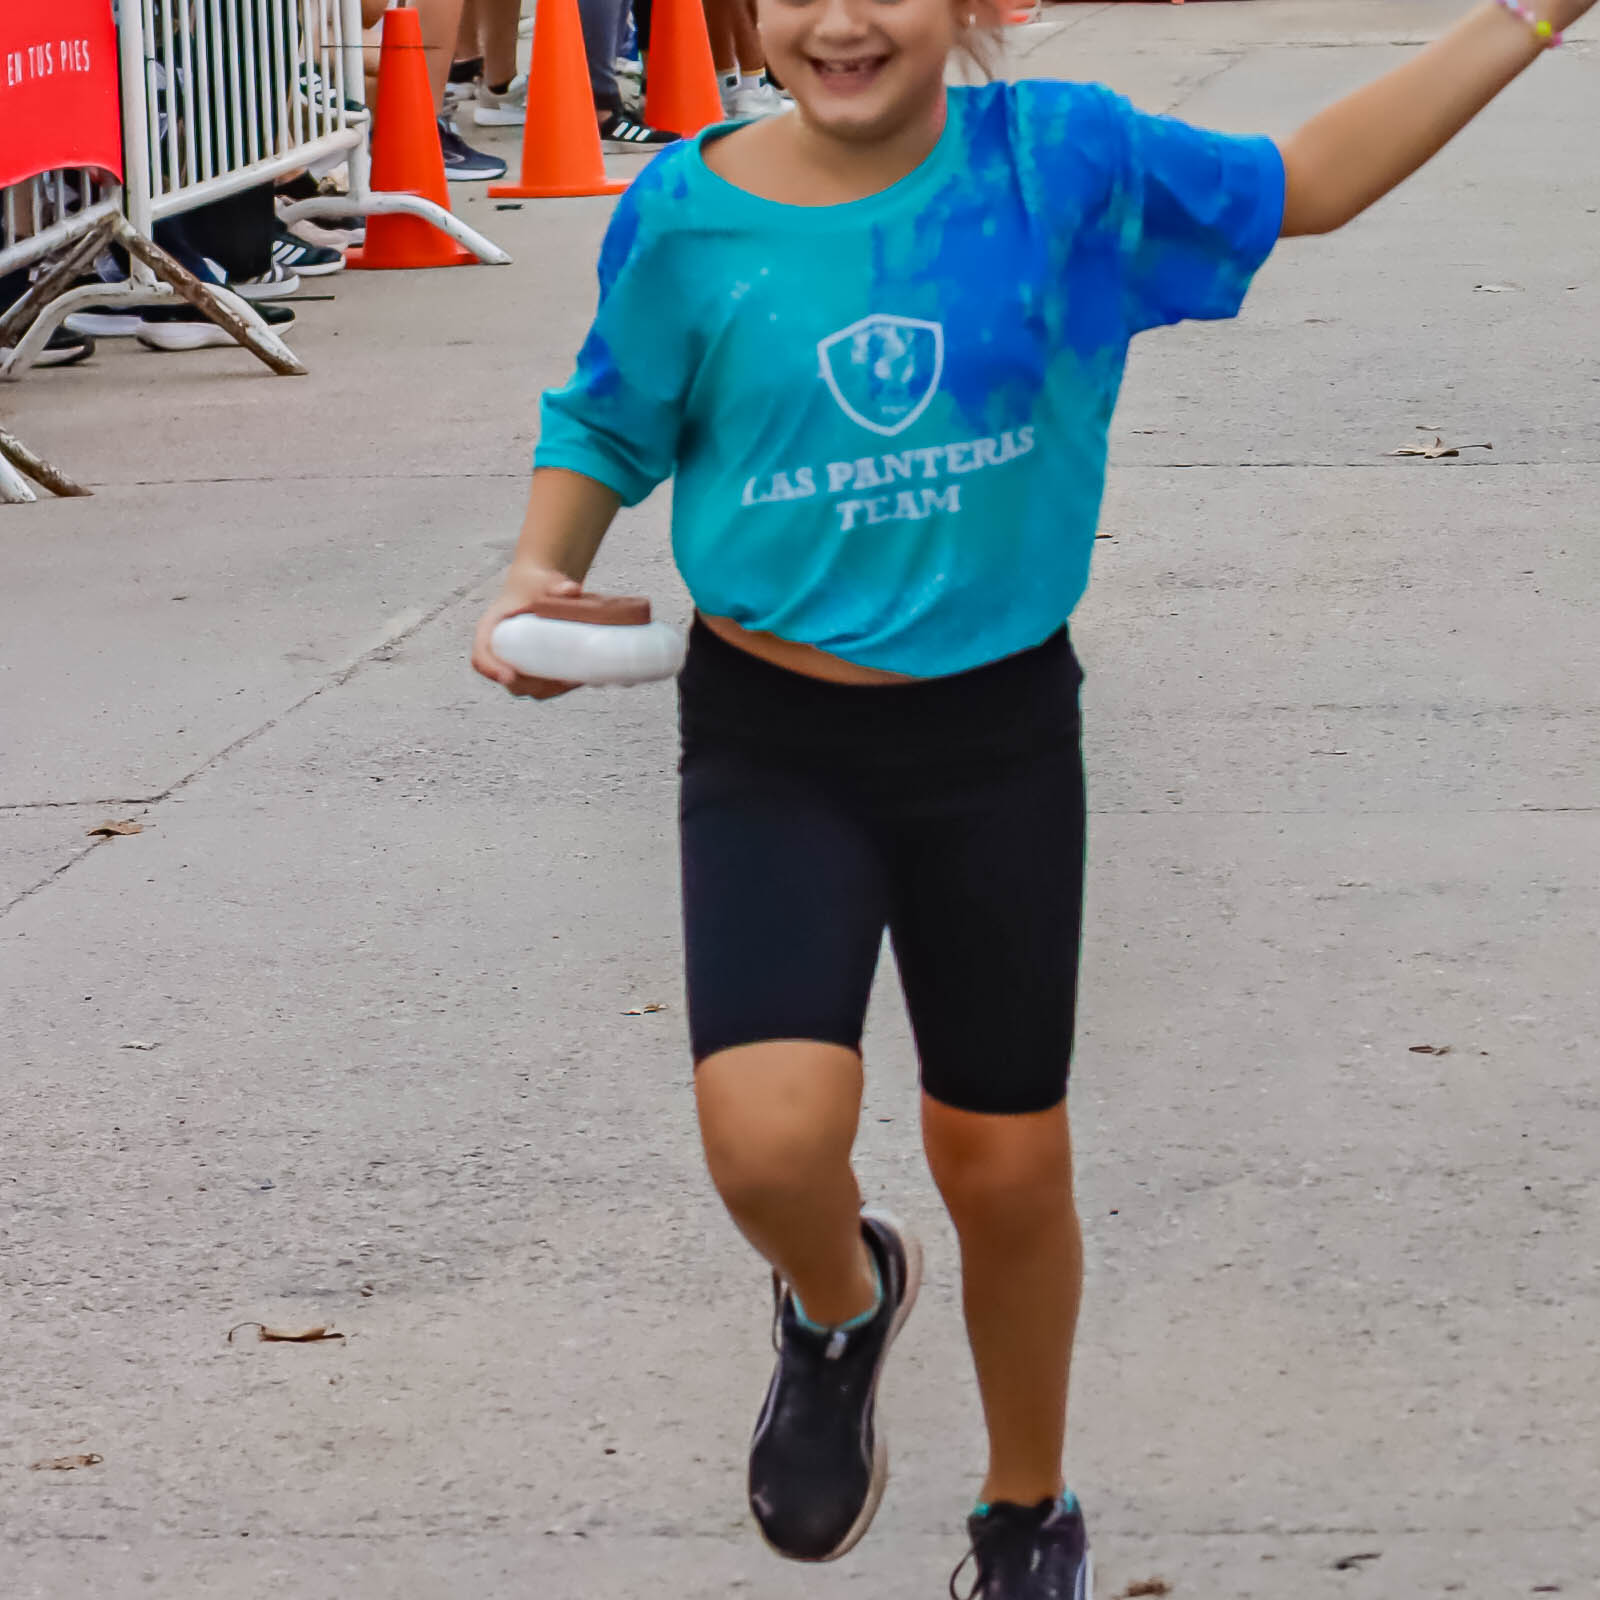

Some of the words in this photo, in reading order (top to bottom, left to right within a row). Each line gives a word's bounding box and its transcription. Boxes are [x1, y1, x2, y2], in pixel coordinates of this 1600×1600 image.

[7, 52, 23, 87] EN
[28, 42, 54, 80] TUS
[60, 39, 91, 73] PIES
[741, 466, 817, 507] LAS
[827, 425, 1036, 494] PANTERAS
[836, 484, 962, 532] TEAM
